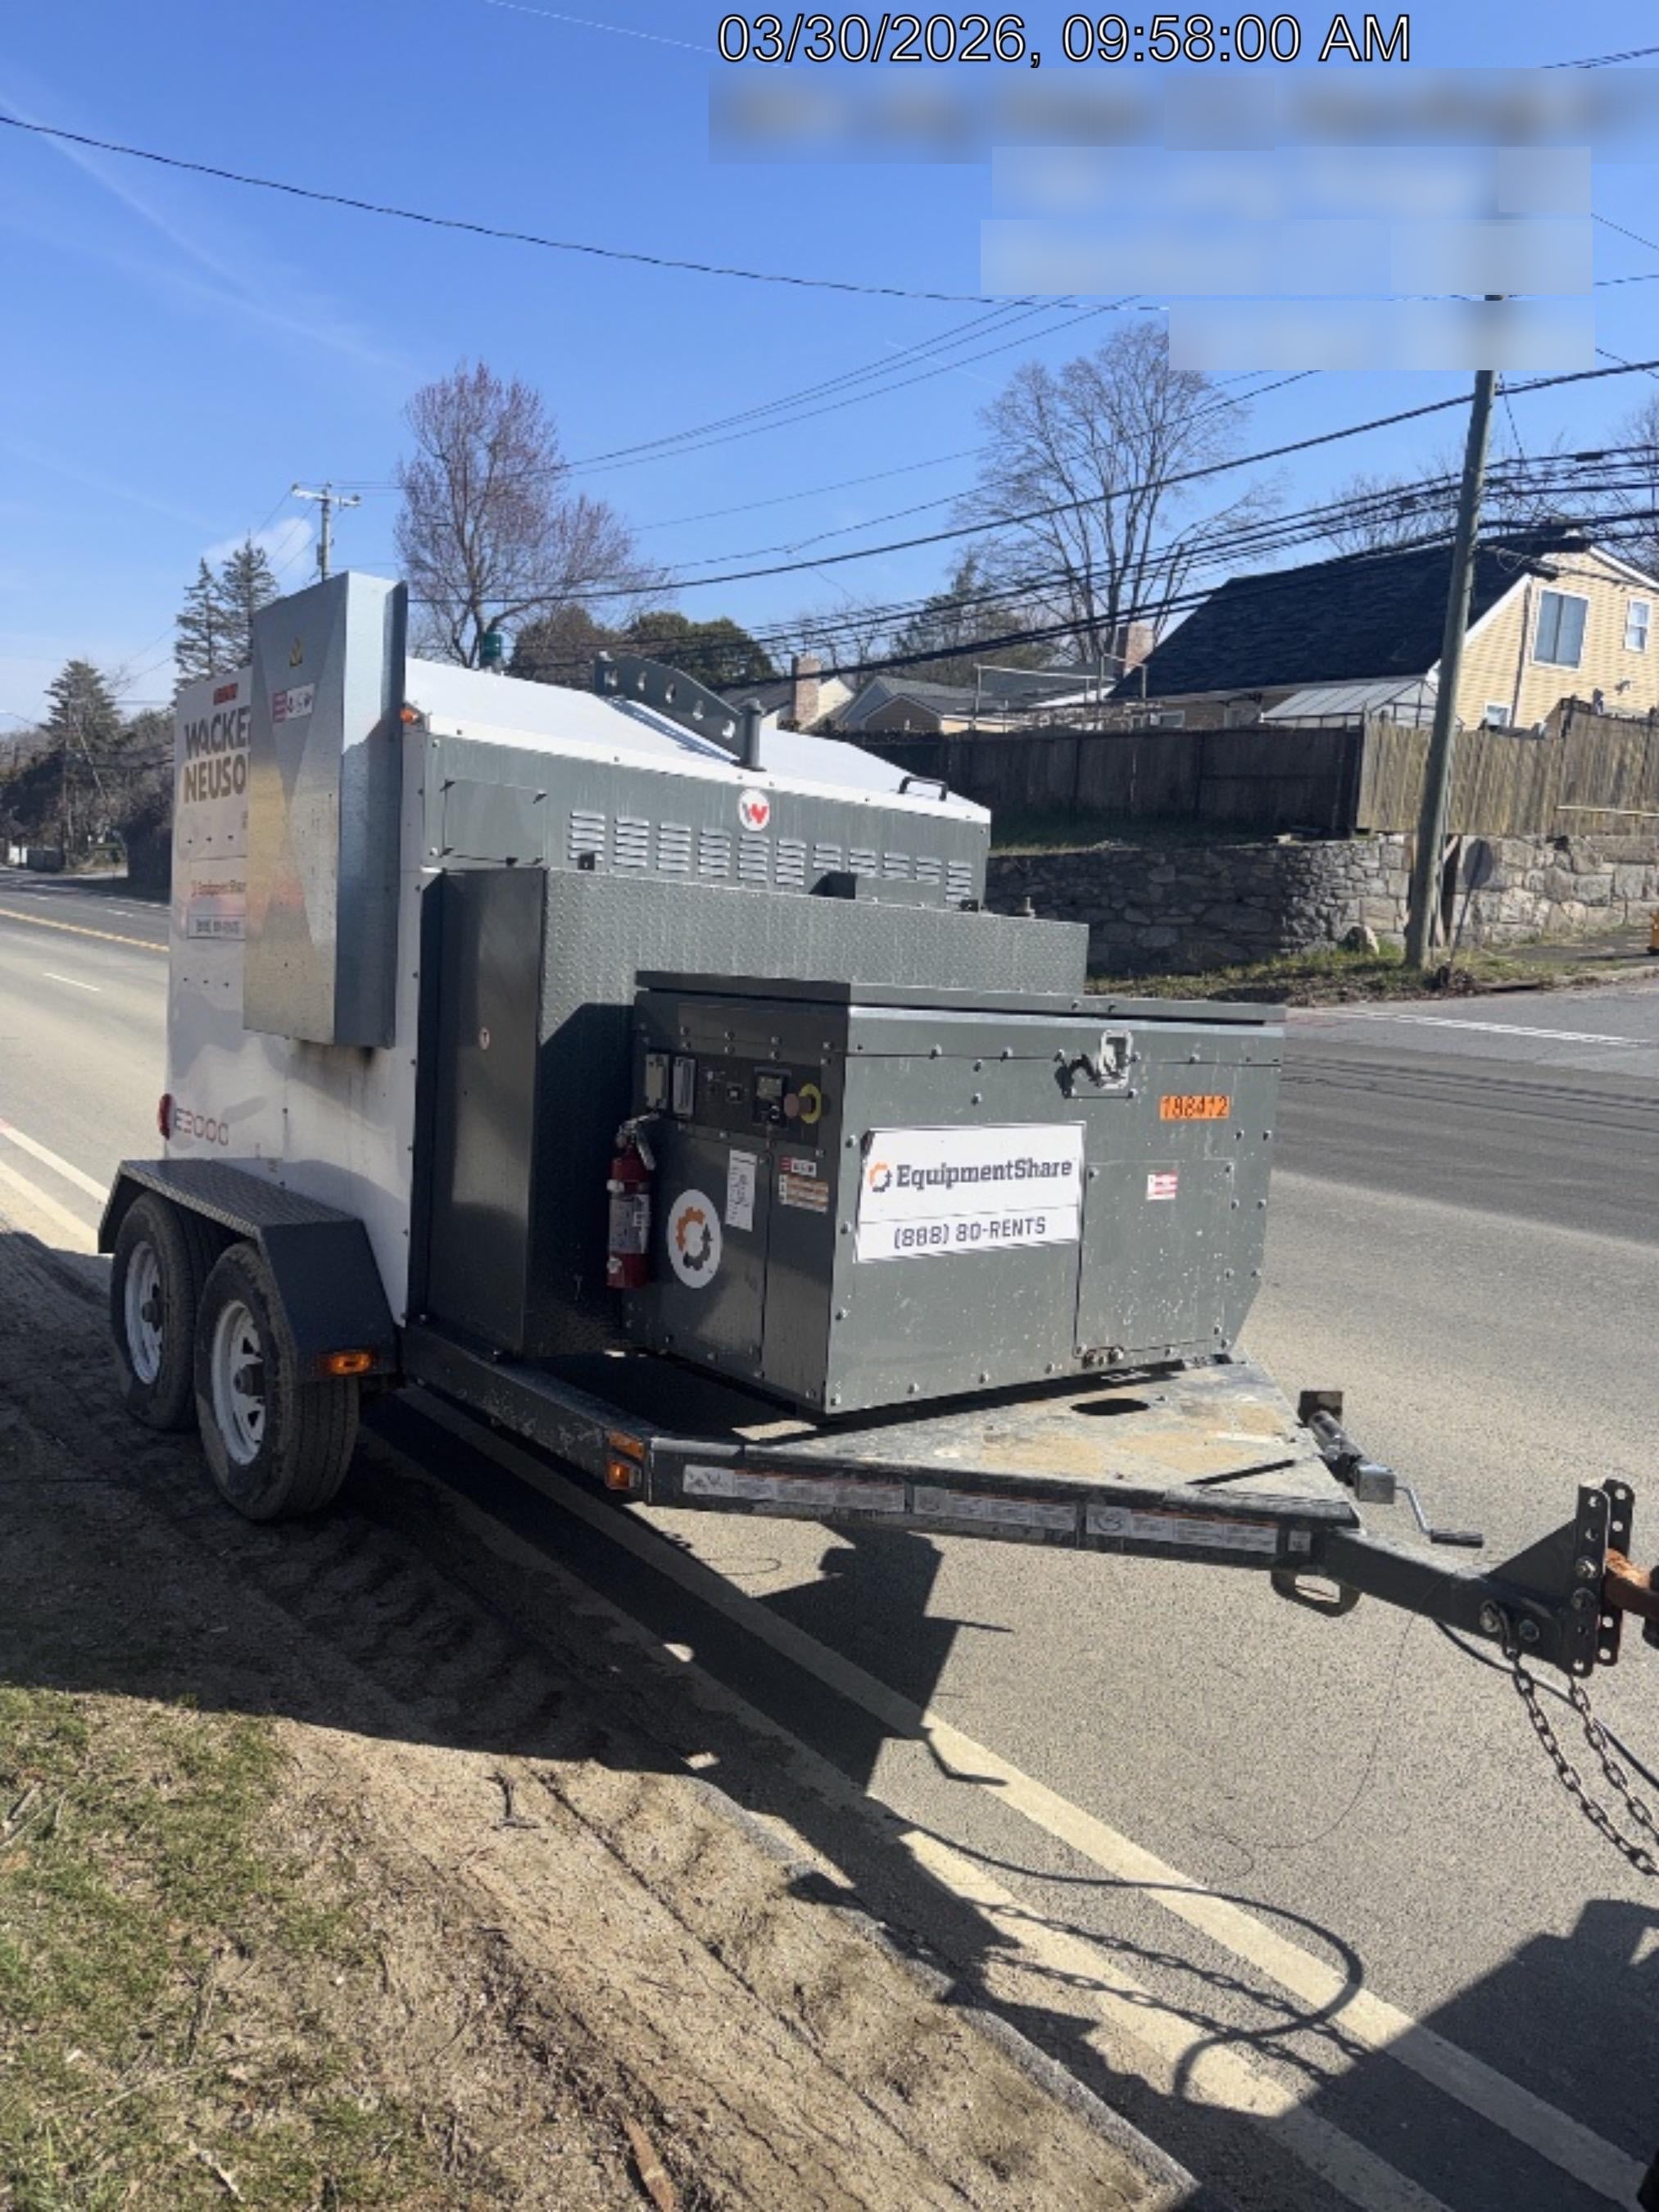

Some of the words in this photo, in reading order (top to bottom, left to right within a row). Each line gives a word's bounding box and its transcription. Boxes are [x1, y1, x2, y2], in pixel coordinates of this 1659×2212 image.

[184, 706, 251, 760] WACKE
[184, 753, 250, 804] NEUSO
[896, 1158, 1072, 1190] EquipmentShare
[894, 1224, 949, 1249] (888)
[955, 1217, 1045, 1242] 80-RENTS
